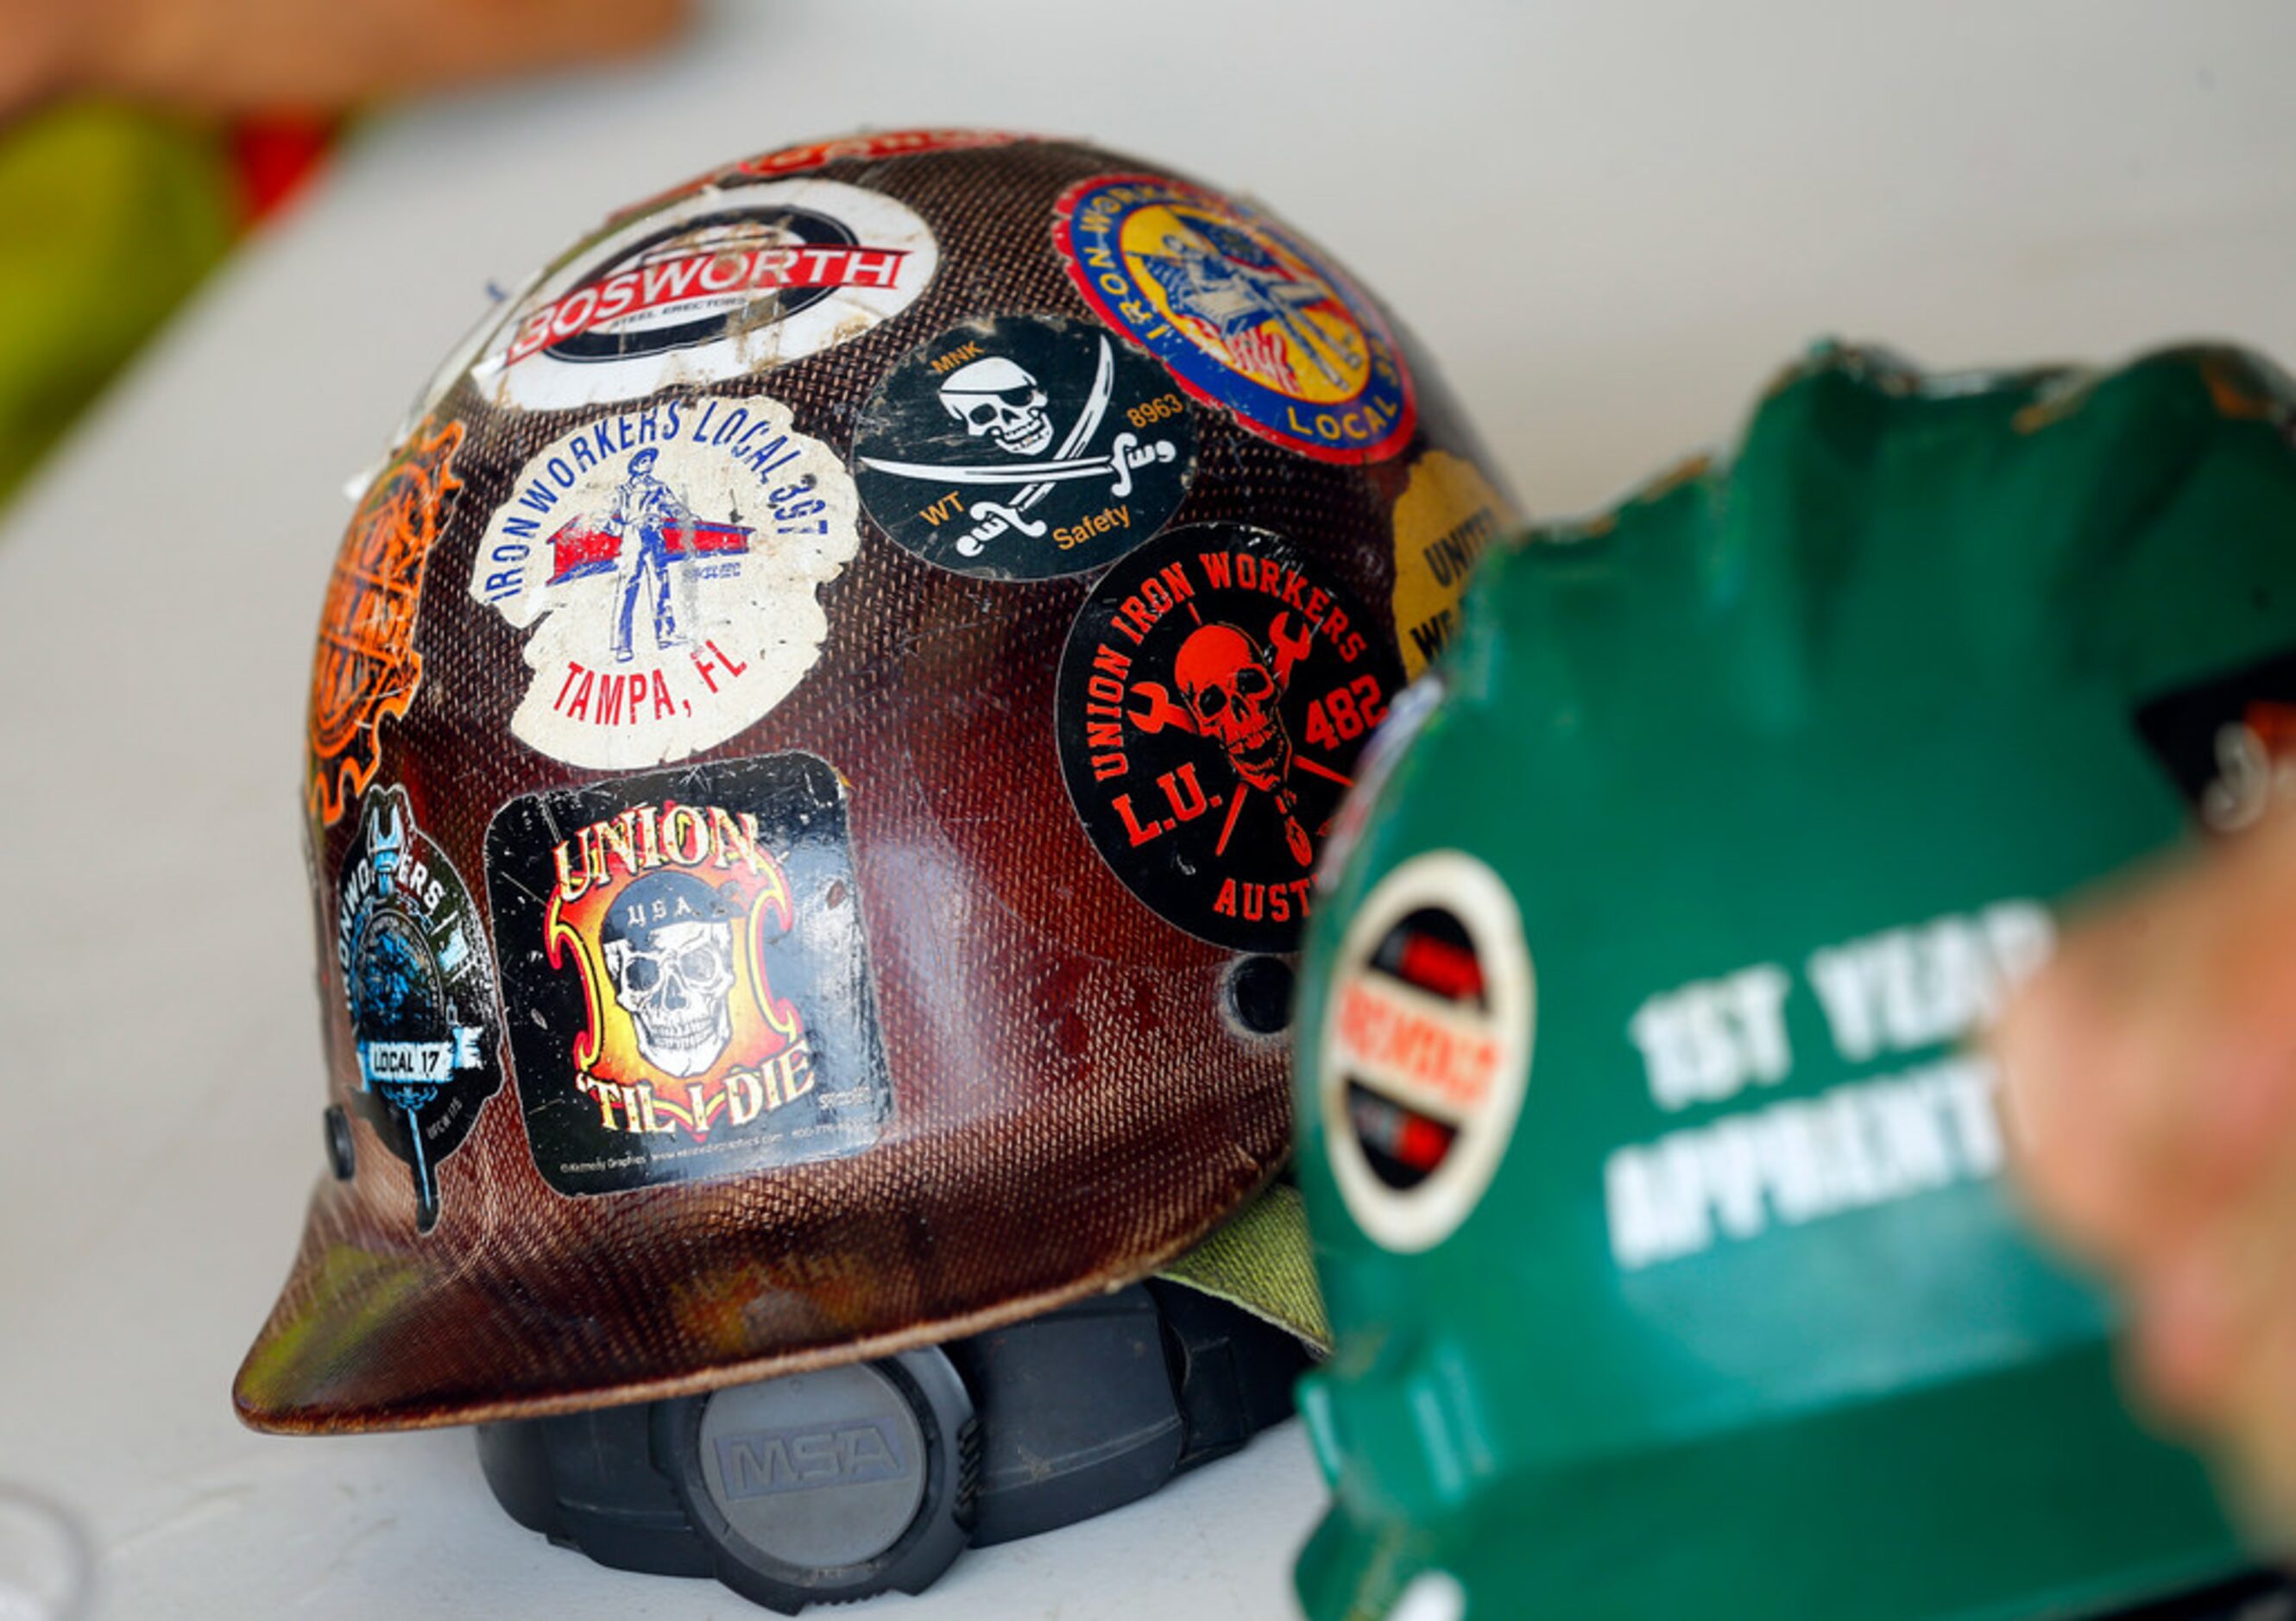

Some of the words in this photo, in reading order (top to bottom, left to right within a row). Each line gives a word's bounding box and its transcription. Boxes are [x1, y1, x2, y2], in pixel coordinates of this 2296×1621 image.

[509, 249, 900, 353] BOSWORTH
[609, 310, 655, 327] STEEL
[662, 298, 748, 315] ERECTORS
[930, 340, 986, 374] MNK
[1126, 393, 1184, 428] 8963
[1287, 394, 1398, 439] LOCAL
[692, 400, 801, 484] LOCAL
[769, 474, 828, 534] 397
[919, 490, 965, 527] WT
[1053, 503, 1131, 551] Safety
[552, 660, 692, 728] TAMPA,
[691, 639, 748, 694] FL
[1087, 643, 1132, 783] UNION
[1111, 561, 1195, 647] IRON
[1199, 551, 1367, 663] WORKERS
[1305, 673, 1389, 752] 482
[1112, 761, 1223, 848] L.U.
[552, 804, 760, 901] UNION
[1213, 873, 1318, 923] AUST
[373, 1050, 415, 1075] LOCAL
[421, 1048, 439, 1074] 17
[688, 1083, 710, 1132] I
[722, 1038, 816, 1127] DIE
[1602, 1049, 2007, 1272] APPRENT
[731, 1426, 900, 1490] MSA
